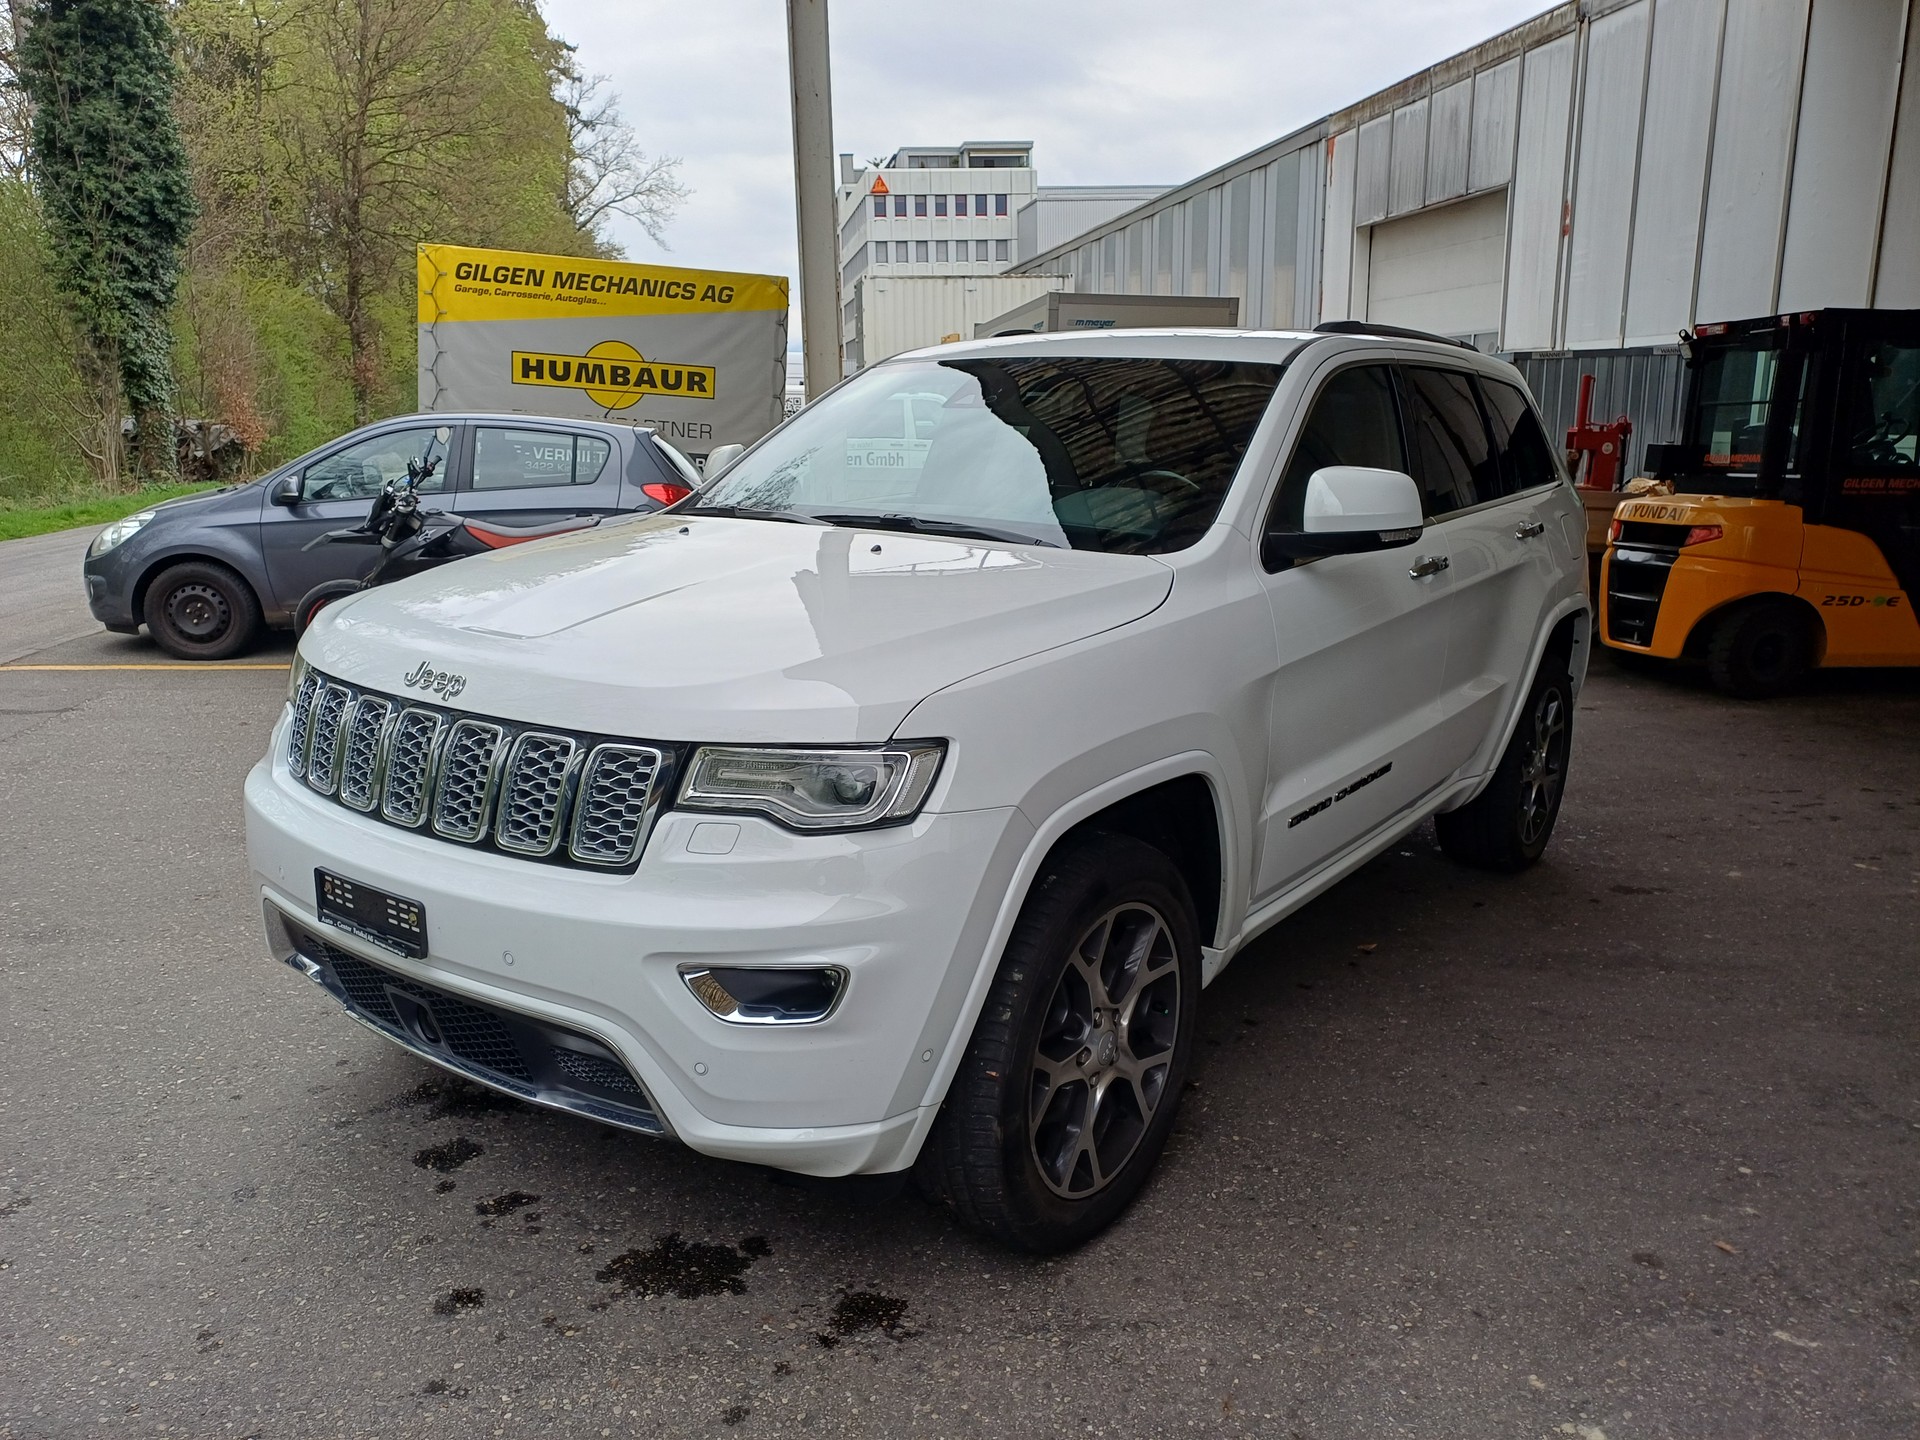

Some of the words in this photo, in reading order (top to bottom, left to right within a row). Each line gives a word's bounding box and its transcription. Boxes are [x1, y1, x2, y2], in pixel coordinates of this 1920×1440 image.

[455, 262, 545, 287] GILGEN
[552, 271, 697, 300] MECHANICS
[700, 284, 734, 304] AG
[454, 284, 492, 297] Garage,
[494, 288, 553, 302] Carrosserie,
[555, 293, 607, 305] Autoglas...
[521, 357, 708, 392] HUMBAUR
[525, 460, 554, 472] 3422
[866, 451, 904, 467] Gmbh
[1843, 478, 1887, 489] GILGEN
[1624, 503, 1684, 522] HYUNDAI
[403, 660, 467, 702] Jeep
